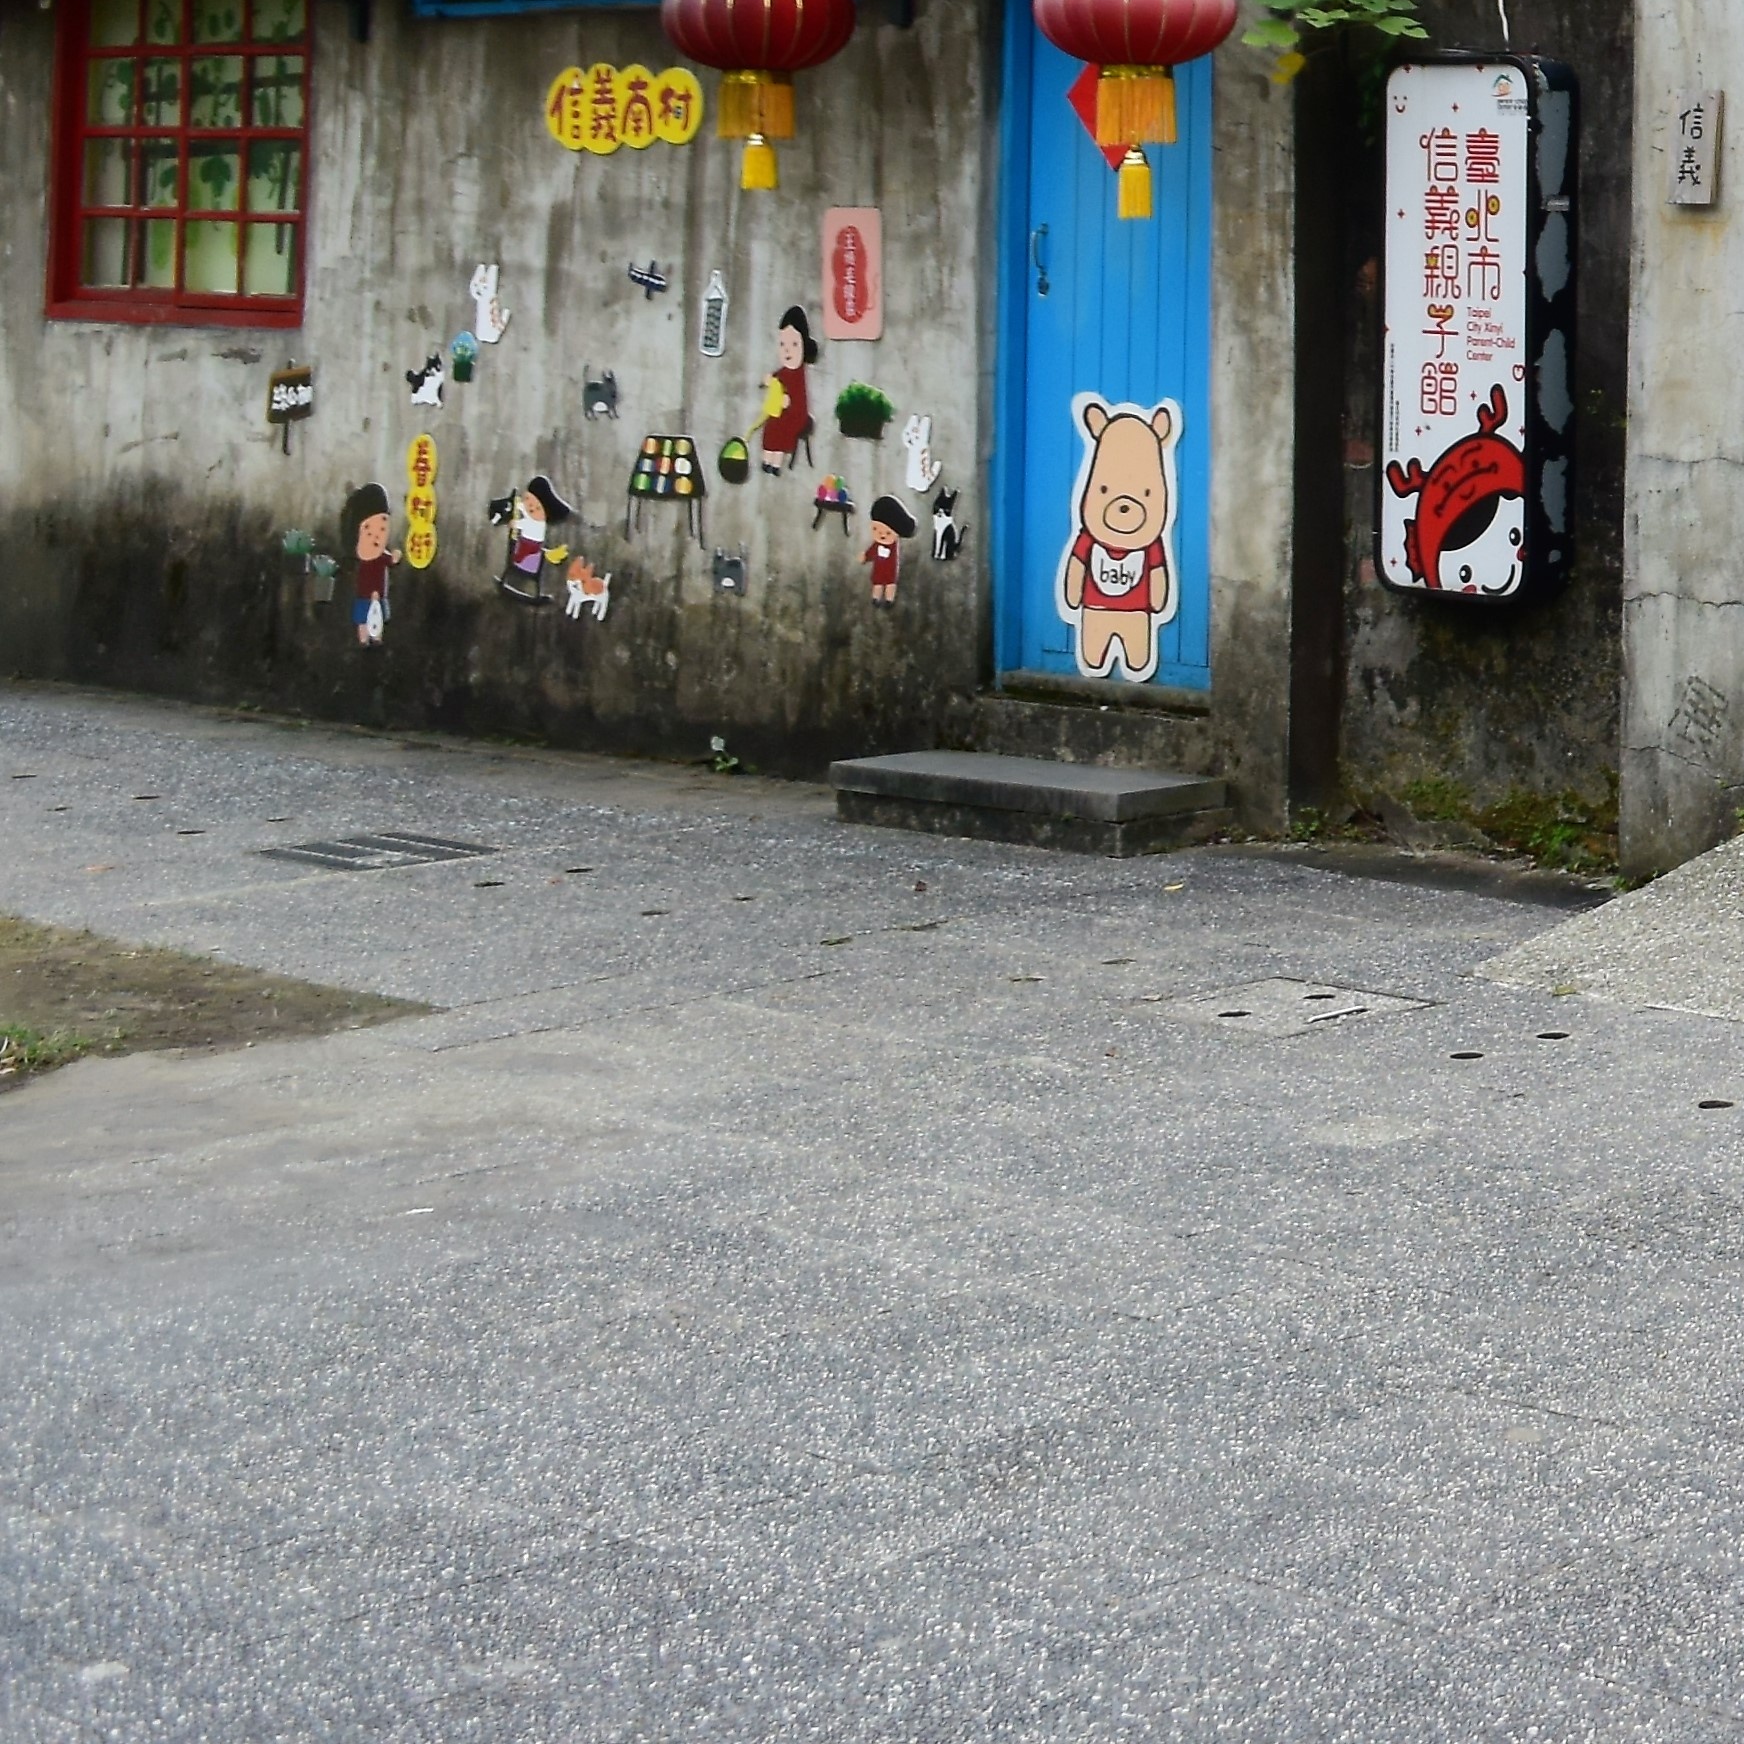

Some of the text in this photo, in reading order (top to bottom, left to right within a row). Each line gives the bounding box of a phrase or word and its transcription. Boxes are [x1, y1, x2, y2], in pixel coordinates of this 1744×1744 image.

[550, 68, 693, 143] 信義南村
[1678, 102, 1704, 187] 信義
[1465, 126, 1501, 301] 臺北市
[1418, 126, 1462, 416] 信義親子館
[1100, 559, 1136, 587] baby
